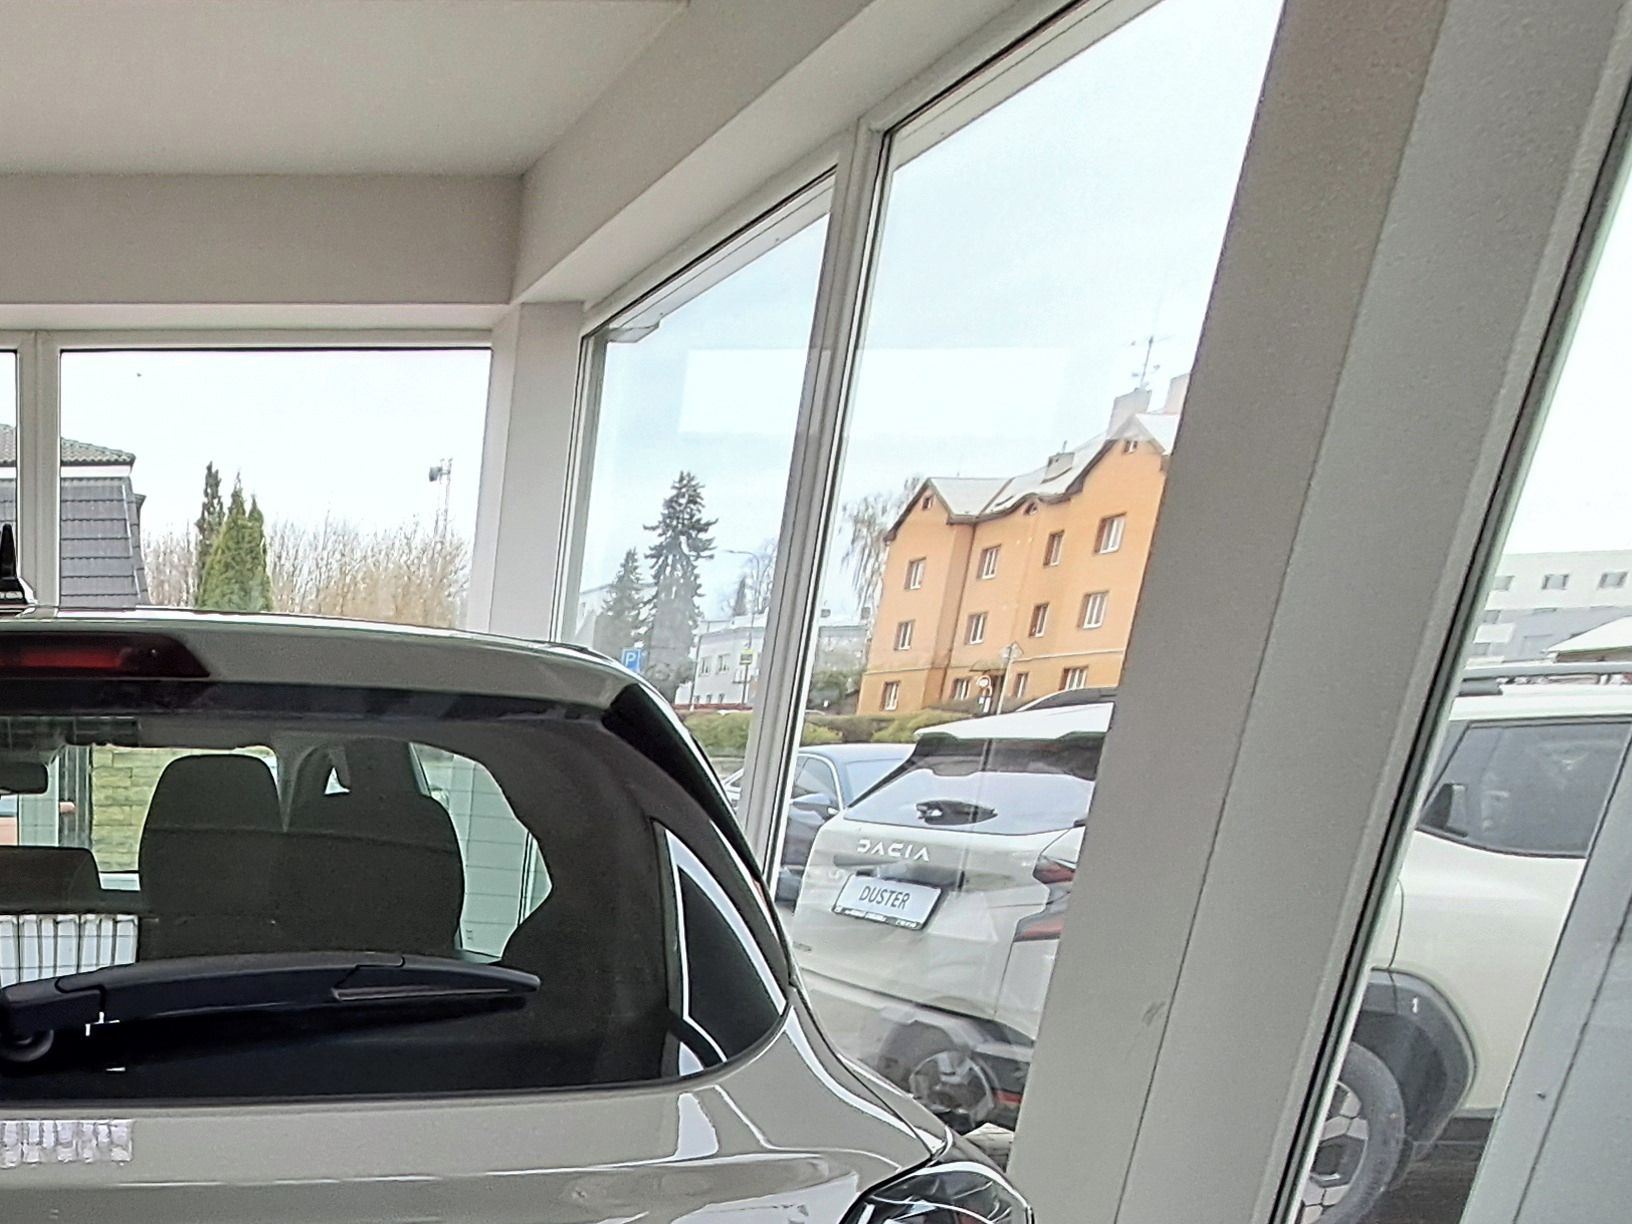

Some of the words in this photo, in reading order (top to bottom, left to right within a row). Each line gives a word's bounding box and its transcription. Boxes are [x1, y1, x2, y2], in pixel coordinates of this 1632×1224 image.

[626, 652, 636, 667] P
[856, 839, 930, 861] DACIA
[859, 886, 910, 910] DUSTER
